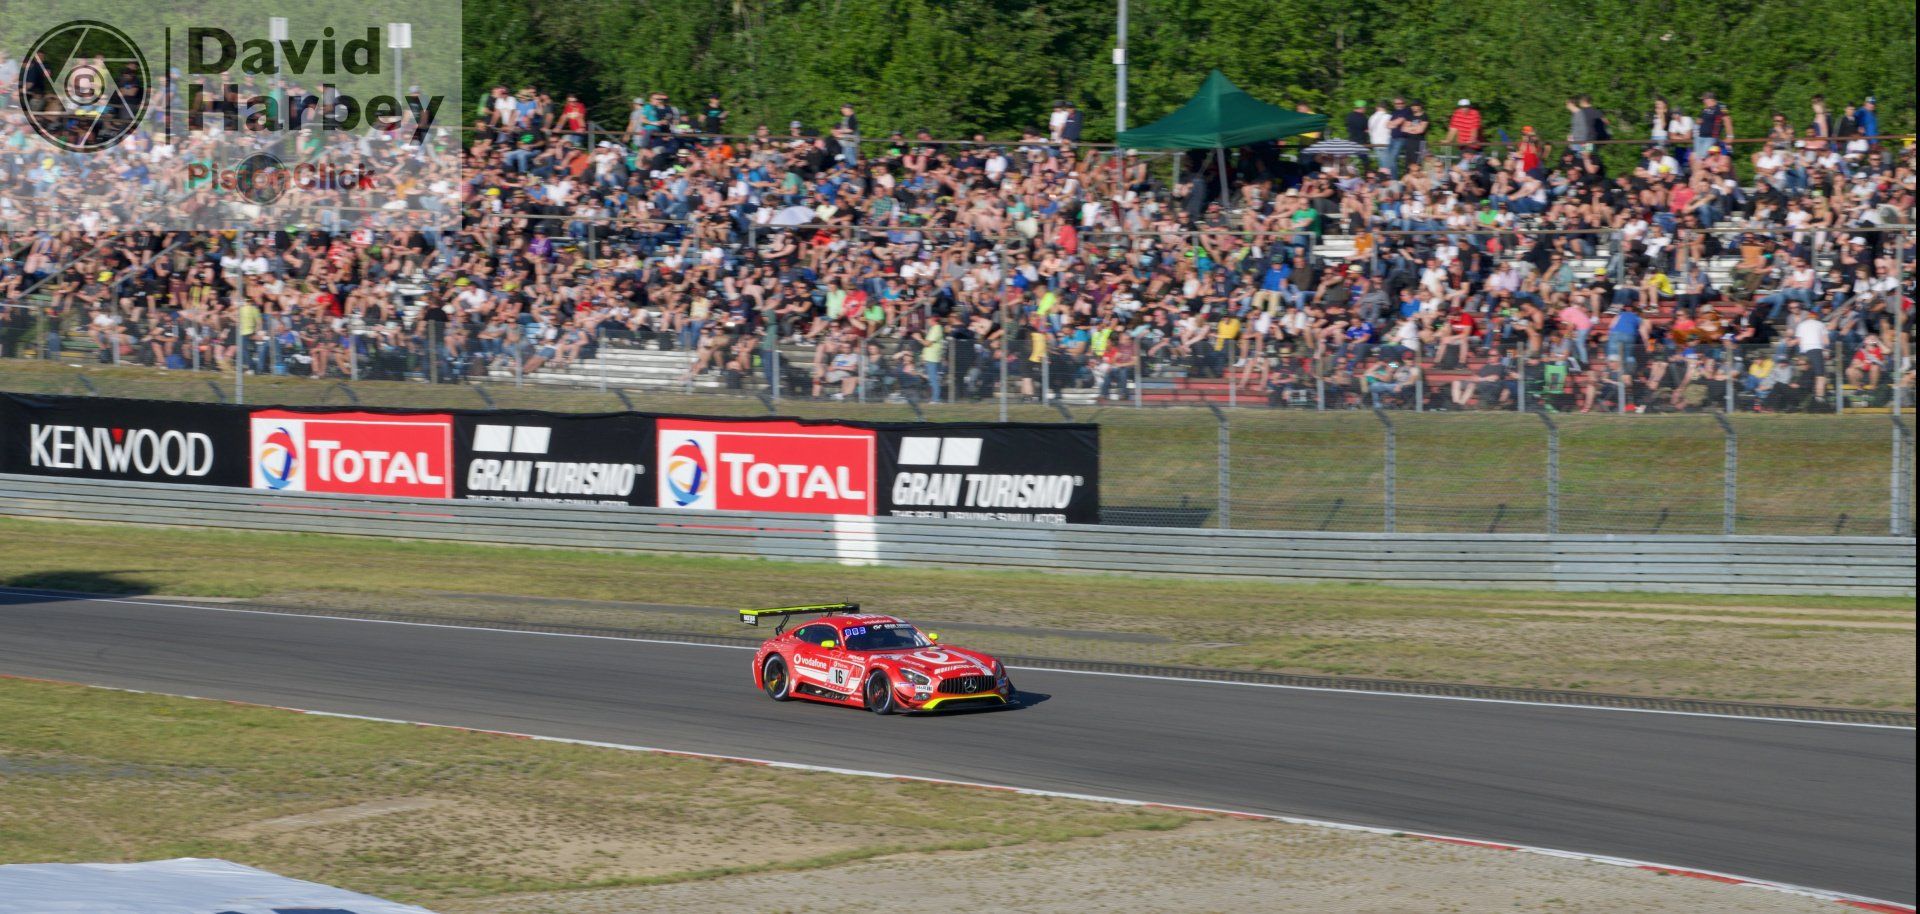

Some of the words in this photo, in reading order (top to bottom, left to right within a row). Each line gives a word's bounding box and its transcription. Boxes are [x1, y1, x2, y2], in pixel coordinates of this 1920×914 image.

[29, 423, 215, 478] KENWOOD
[307, 439, 445, 486] TOTAL
[467, 458, 534, 492] GRAN
[719, 451, 867, 500] TOTAL
[891, 471, 963, 507] GRAN
[801, 656, 828, 670] vodafone
[834, 668, 844, 685] 16
